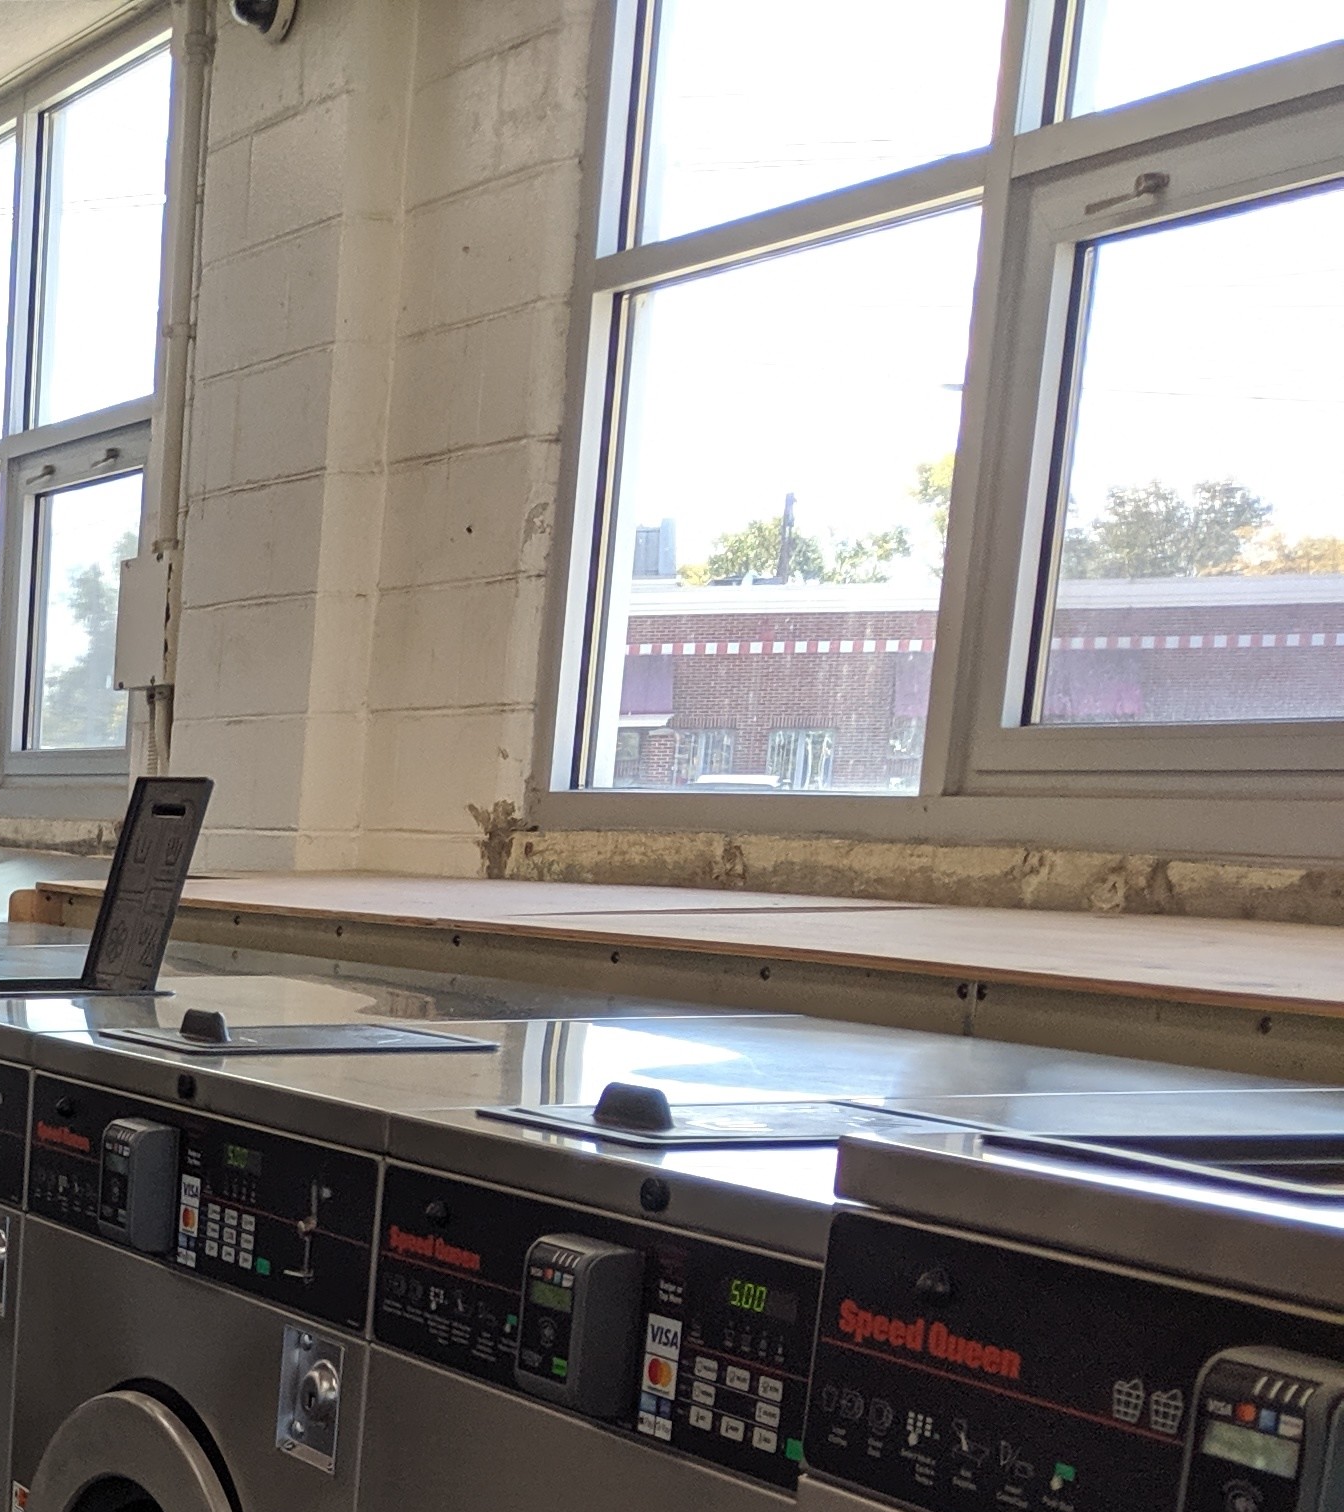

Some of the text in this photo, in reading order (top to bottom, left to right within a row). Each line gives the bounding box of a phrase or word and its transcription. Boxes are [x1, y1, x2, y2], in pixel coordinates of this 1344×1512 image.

[650, 1323, 680, 1350] VISA
[839, 1299, 1022, 1380] Speed Queen
